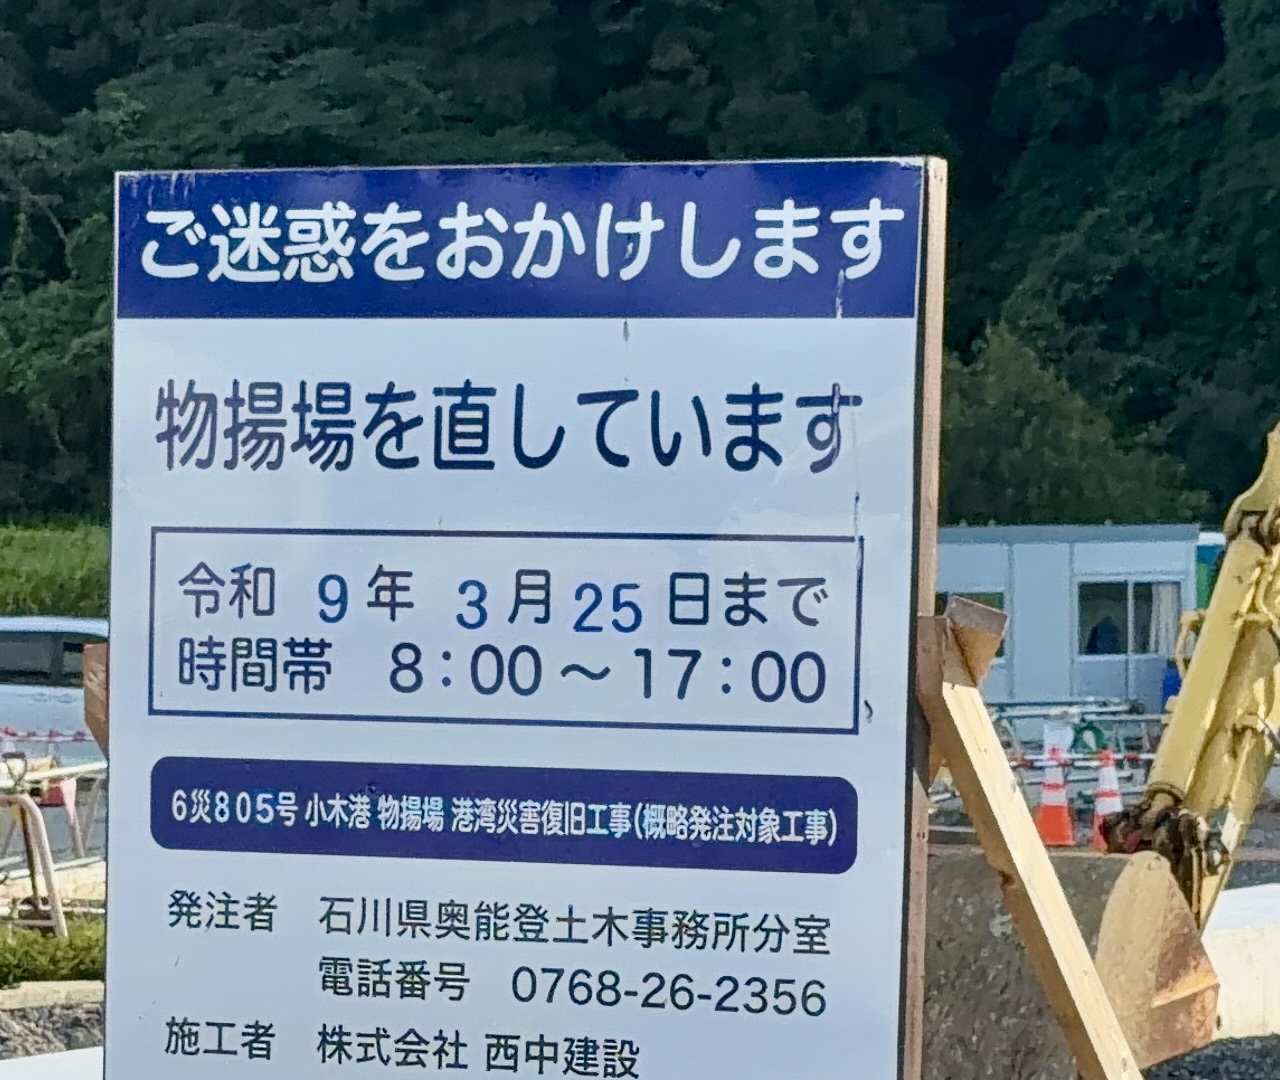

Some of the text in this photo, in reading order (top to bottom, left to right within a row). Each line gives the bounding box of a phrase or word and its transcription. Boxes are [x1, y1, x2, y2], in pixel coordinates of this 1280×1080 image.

[141, 197, 905, 283] ご迷惑をおかけします
[155, 378, 863, 474] 物揚場を直しています
[177, 561, 276, 620] 令和
[178, 636, 333, 695] 時間帯
[171, 788, 299, 827] 6災805号
[167, 889, 831, 956] 発注者 石川県奥能登土木事務所分室
[318, 955, 827, 1017] 電話番号 0768-26-2356
[164, 1016, 640, 1080] 施工者 株式会社 西中建設
